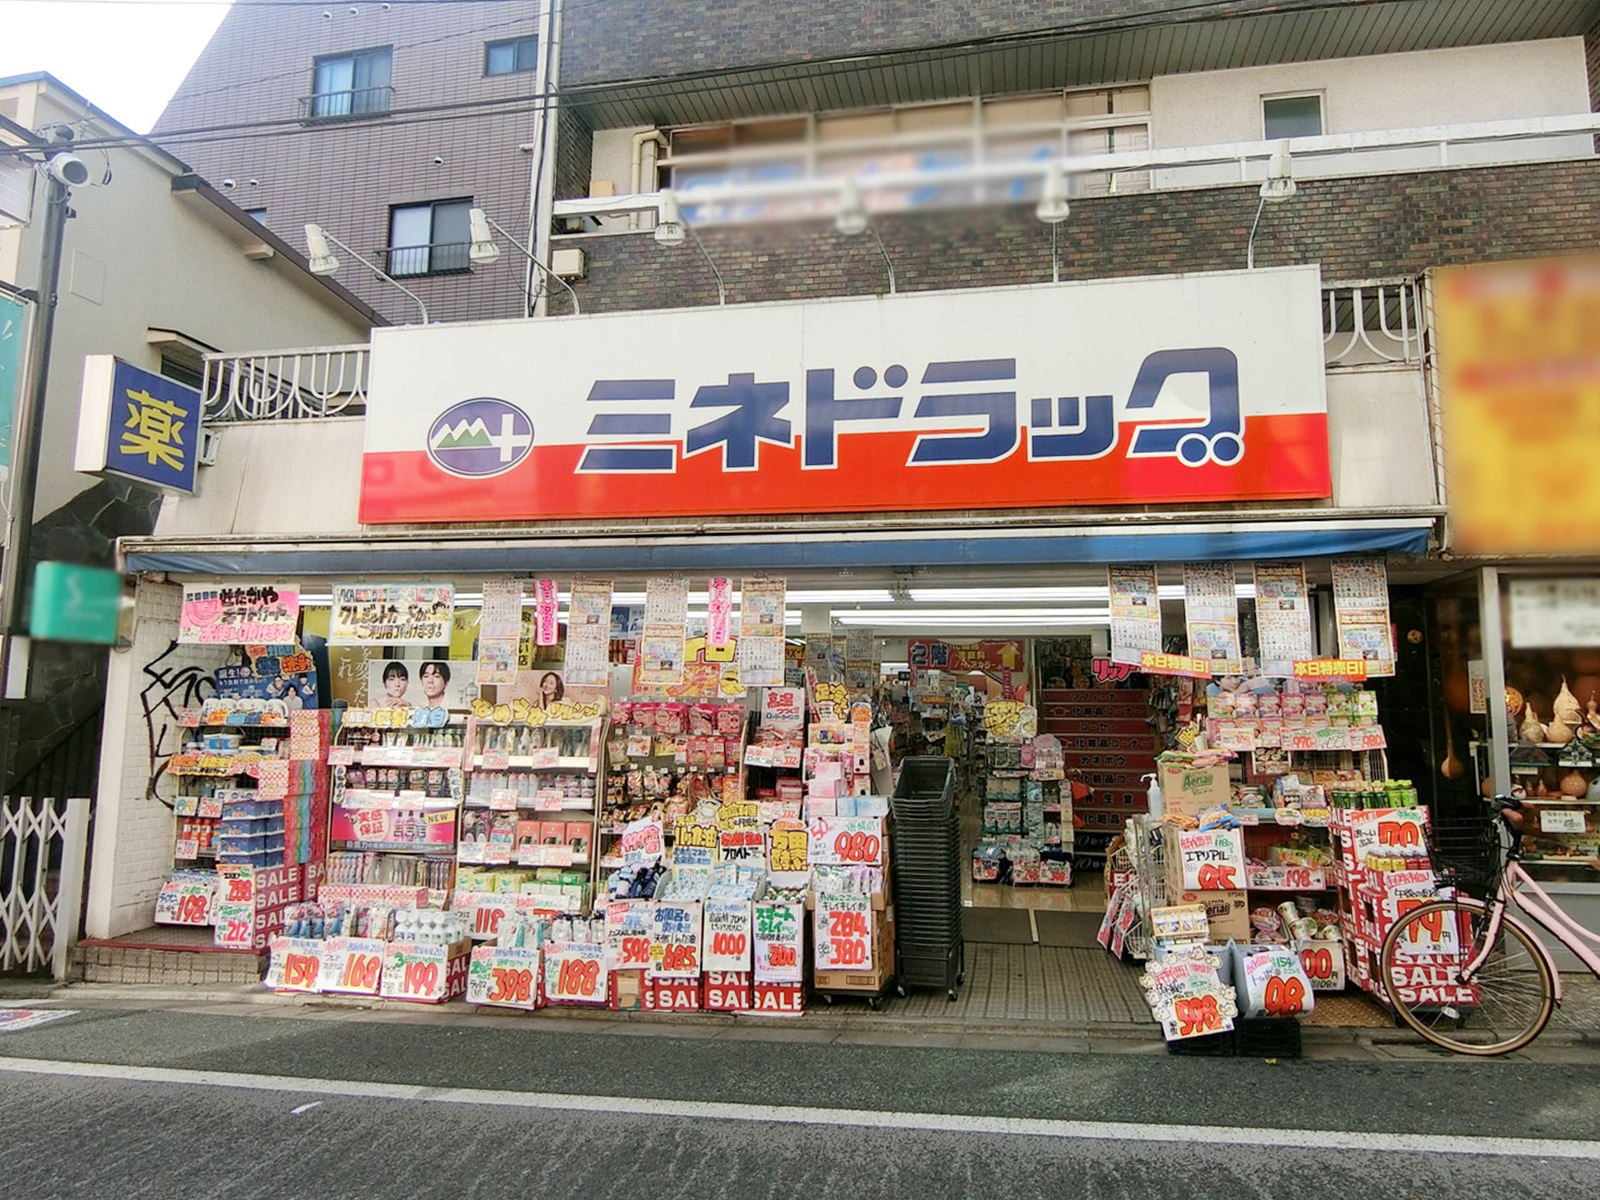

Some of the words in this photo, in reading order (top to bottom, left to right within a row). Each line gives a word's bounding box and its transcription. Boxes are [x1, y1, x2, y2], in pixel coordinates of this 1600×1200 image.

[573, 348, 1247, 477] ミネドラッグ
[118, 388, 189, 472] 薬
[1142, 652, 1209, 674] 本日特売日!
[1294, 660, 1364, 676] 本日特売日!
[1075, 739, 1150, 748] 化粧品コーナー
[1080, 756, 1126, 766] カネボウ
[359, 809, 383, 823] 実感
[360, 821, 383, 836] 保証
[428, 813, 449, 823] NEW
[834, 831, 880, 863] 980
[256, 867, 298, 889] SALE
[176, 894, 208, 922] 198
[256, 886, 298, 909] SALE
[227, 921, 249, 942] 212
[829, 911, 868, 938] 284
[622, 937, 652, 963] 598
[713, 932, 746, 955] 1000
[829, 938, 866, 964] 380
[663, 943, 697, 971] 685
[284, 953, 320, 988] 159
[343, 953, 381, 989] 168
[404, 961, 438, 996] 199
[558, 958, 600, 996] 188
[1391, 965, 1461, 987] SALE
[489, 967, 533, 1001] 398
[1264, 975, 1305, 1016] 98
[1398, 987, 1474, 1003] SALE
[1174, 994, 1222, 1036] 598
